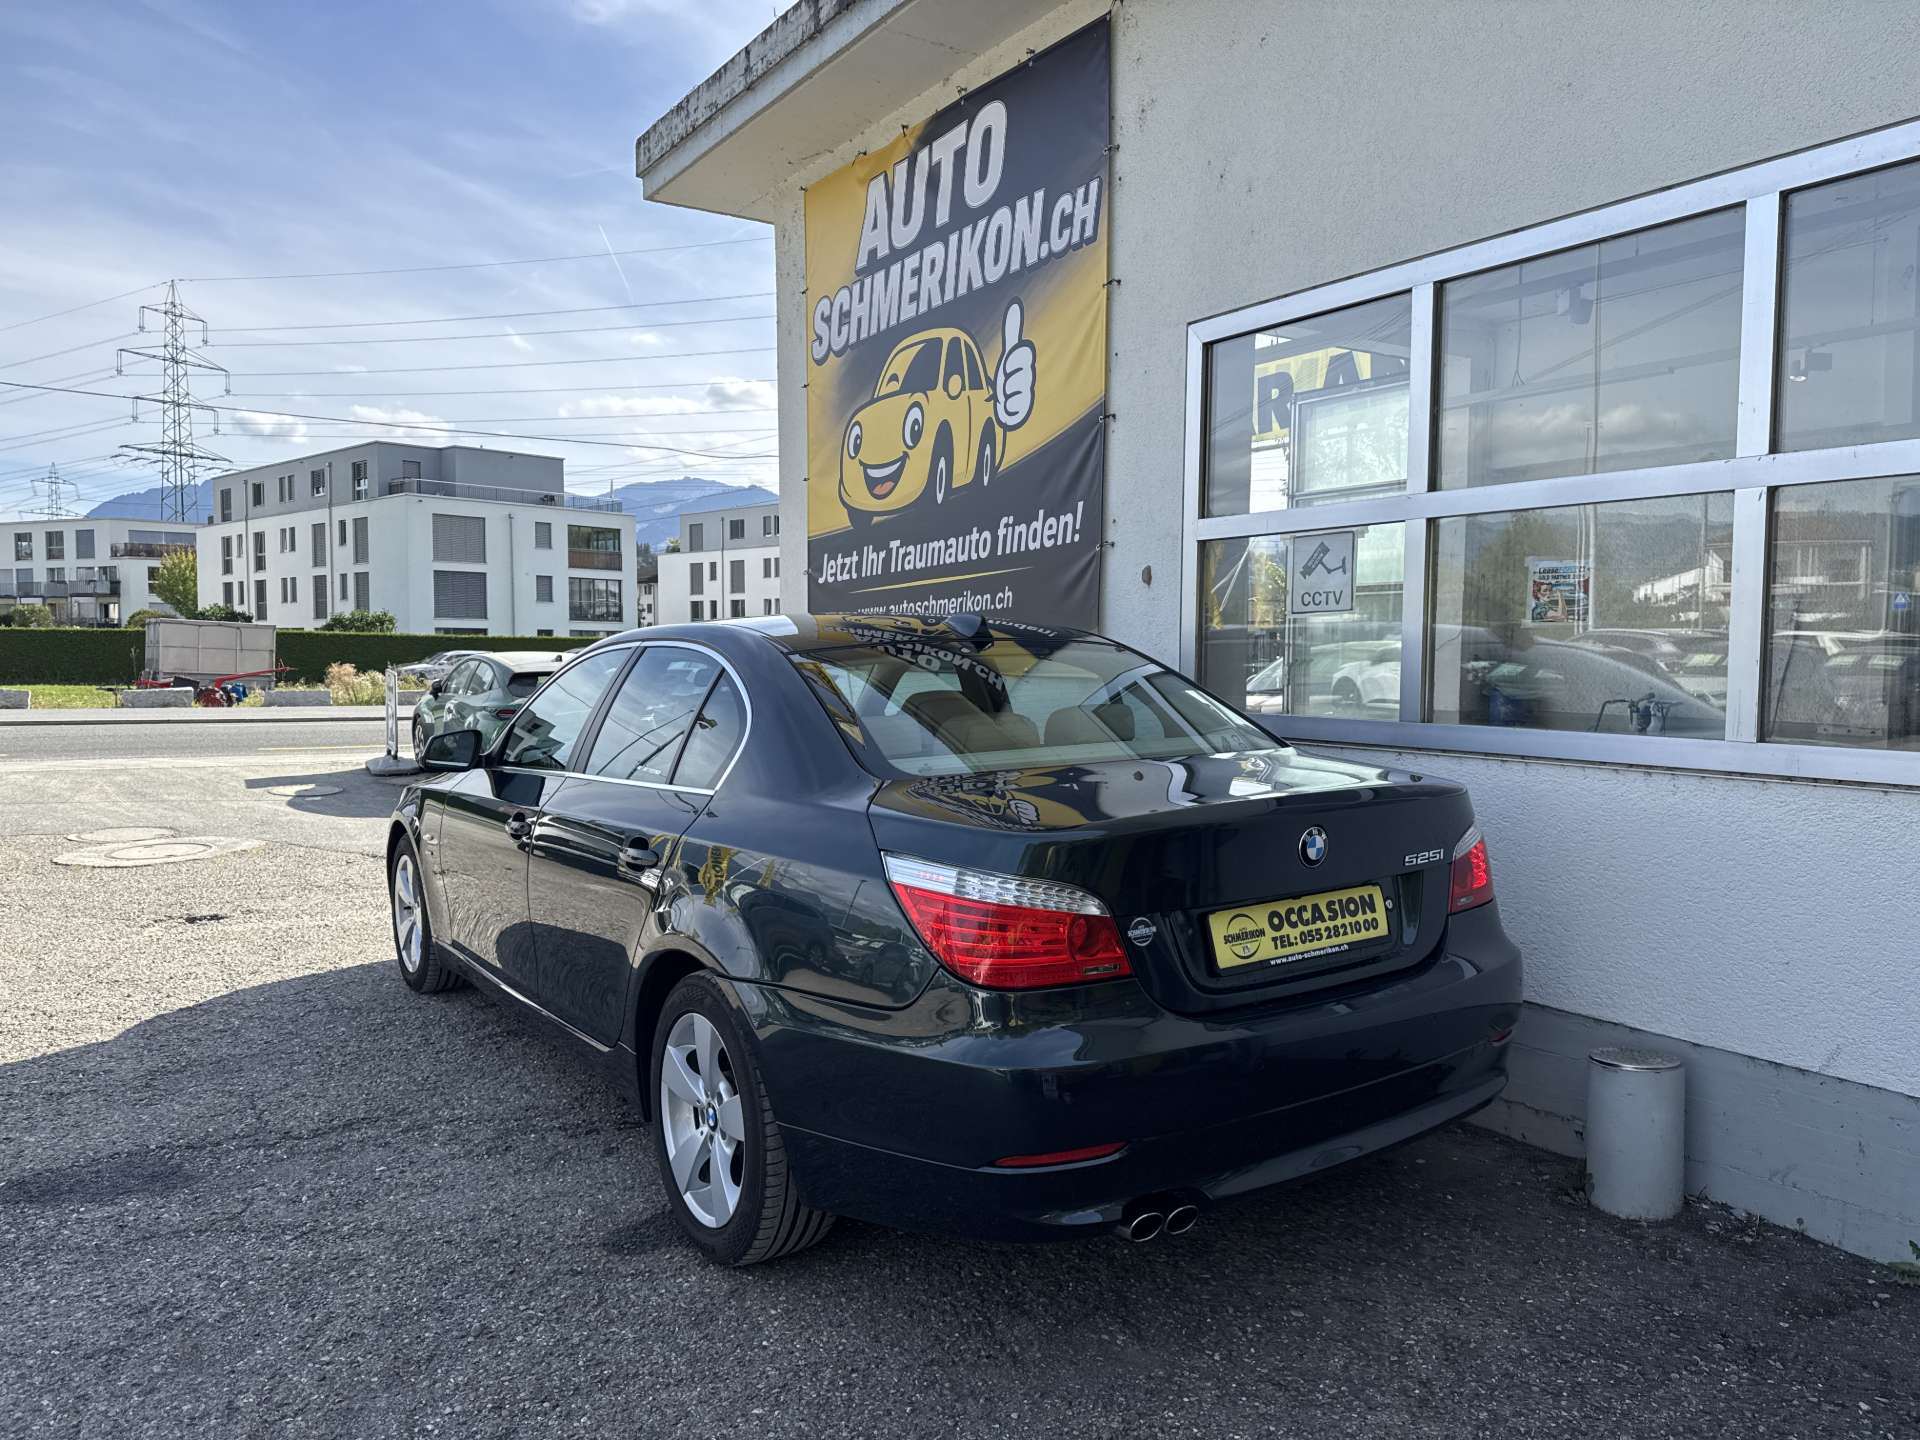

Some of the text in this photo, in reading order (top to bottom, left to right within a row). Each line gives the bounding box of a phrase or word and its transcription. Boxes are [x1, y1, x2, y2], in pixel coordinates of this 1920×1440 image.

[856, 100, 1007, 270] AUTO
[811, 176, 1101, 362] SCHMERIKON.CH
[818, 501, 1084, 584] Jetzt Ihr Traumauto finden!
[1301, 590, 1343, 606] CCTV
[1224, 928, 1266, 945] SCHMERIKON
[1268, 894, 1376, 932] OCCASION
